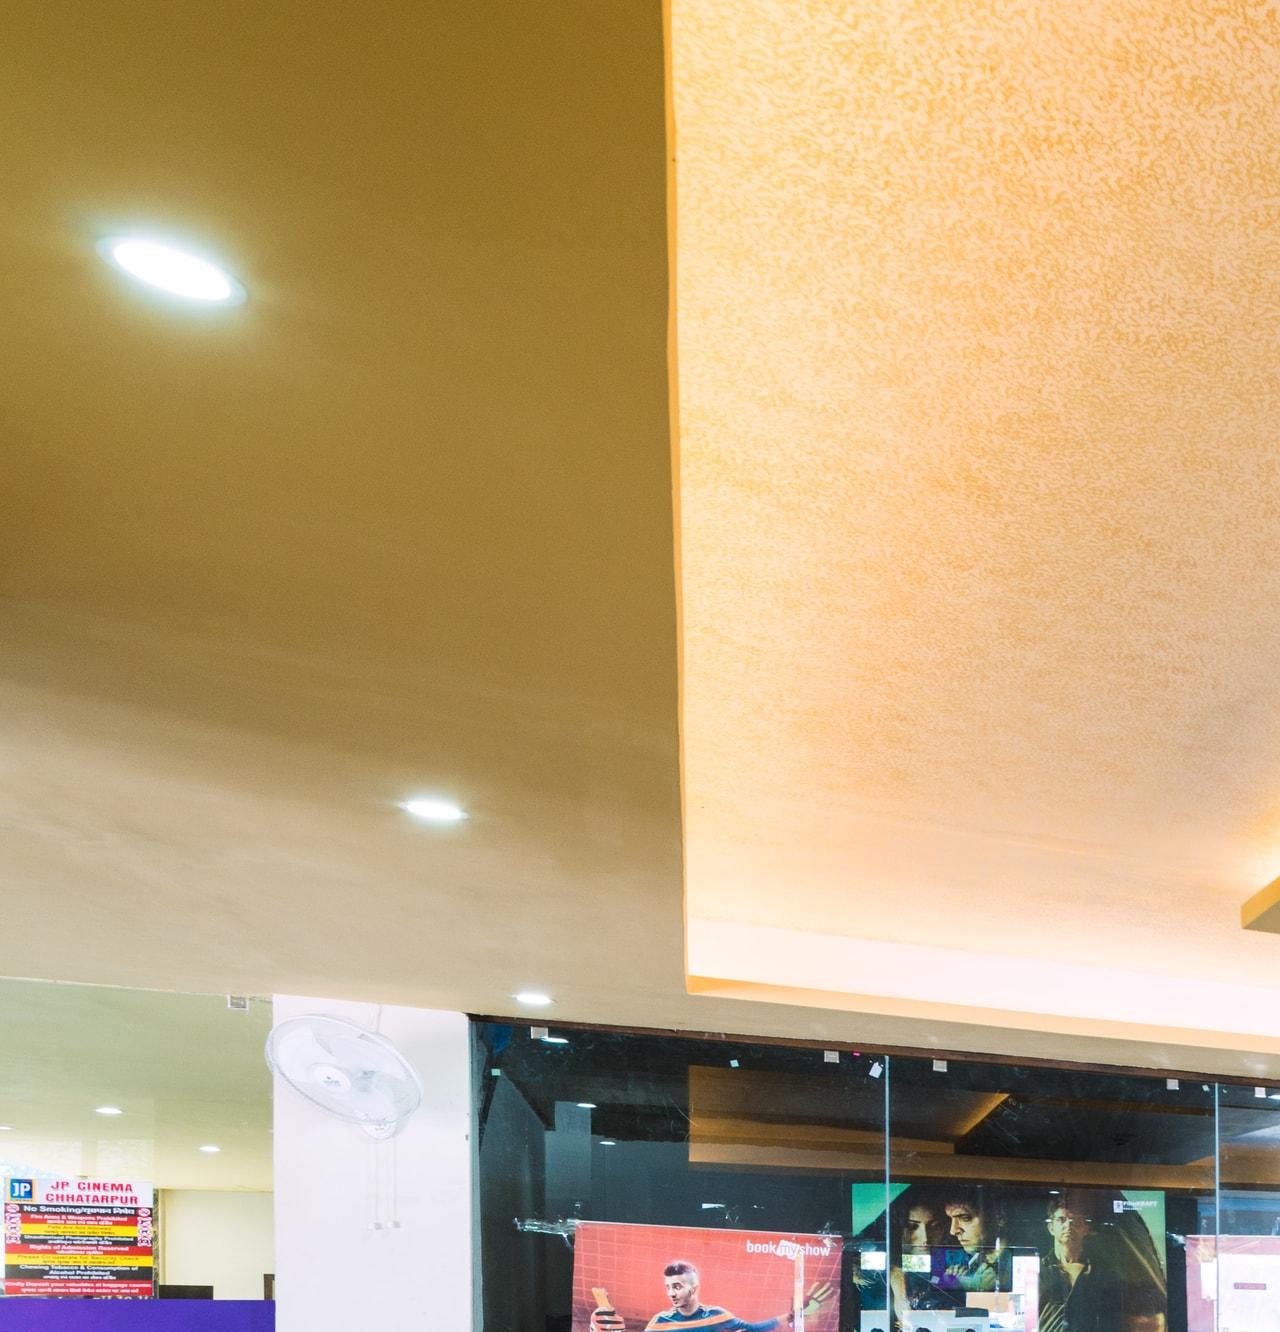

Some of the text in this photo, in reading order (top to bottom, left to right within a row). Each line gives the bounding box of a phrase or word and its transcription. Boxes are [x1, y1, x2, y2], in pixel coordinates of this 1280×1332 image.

[13, 1183, 31, 1197] JP
[50, 1181, 133, 1192] JP CINEMA
[45, 1193, 138, 1205] CHHATARPUR
